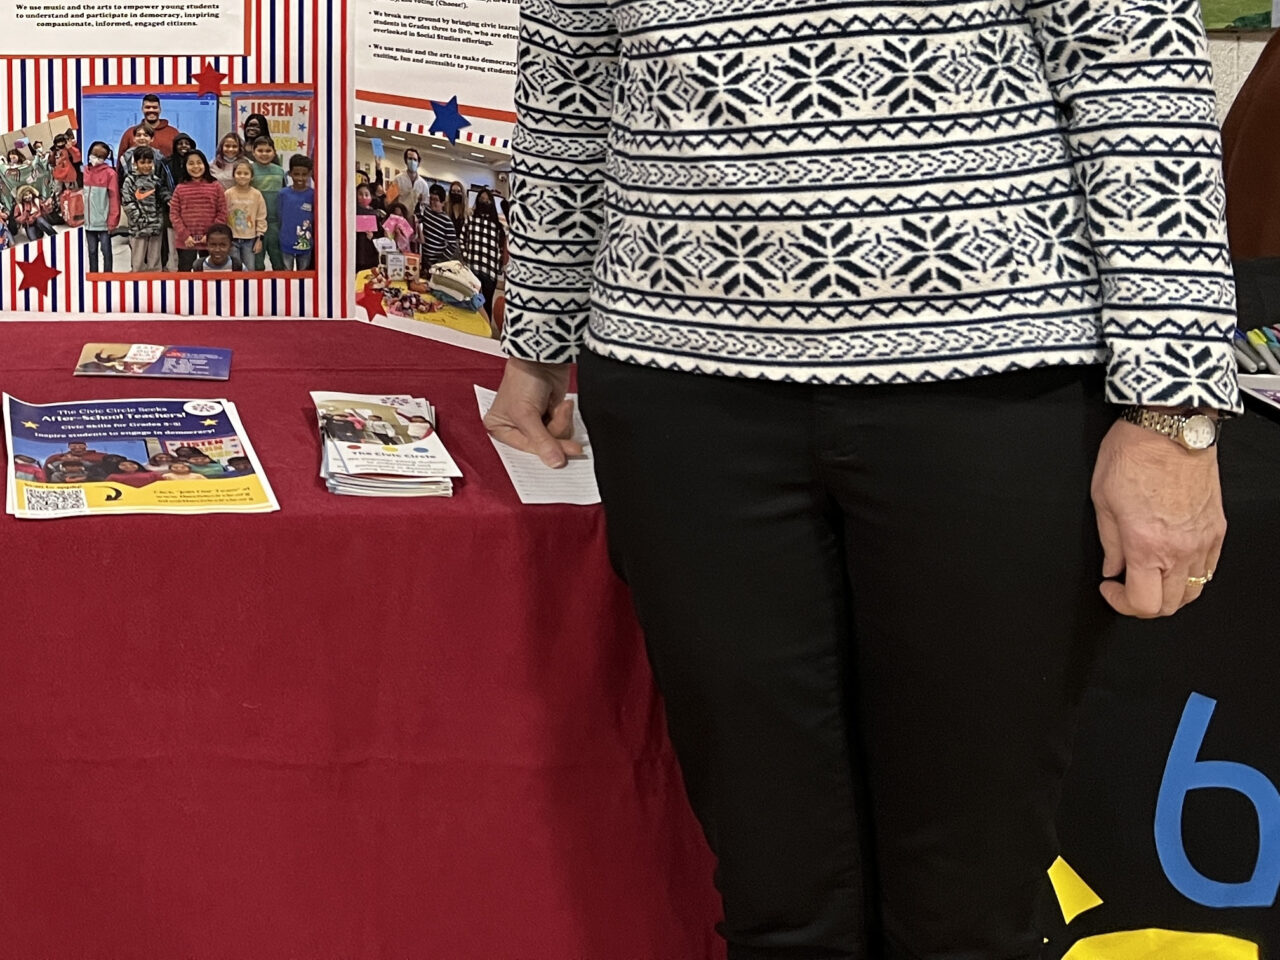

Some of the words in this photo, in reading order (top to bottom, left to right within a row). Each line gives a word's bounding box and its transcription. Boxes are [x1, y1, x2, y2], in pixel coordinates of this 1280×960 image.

[183, 11, 219, 19] inspiring
[251, 102, 293, 116] LISTEN
[42, 413, 124, 422] After-School
